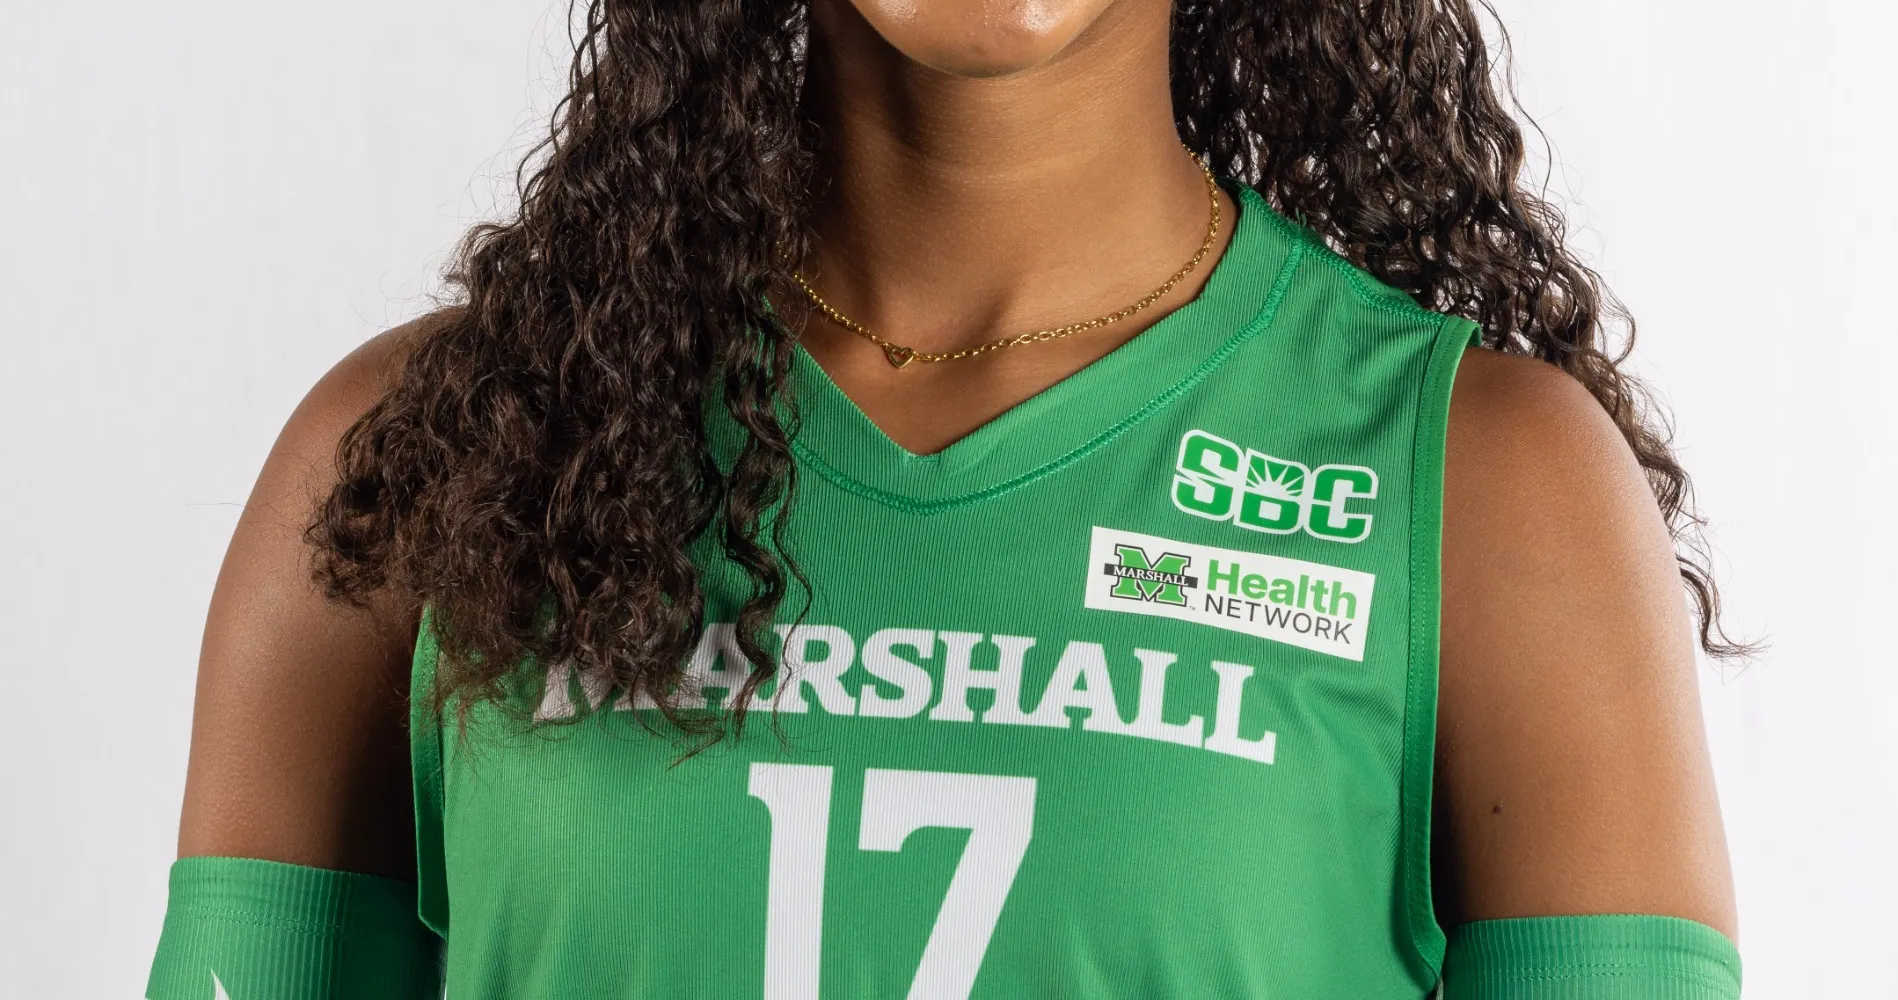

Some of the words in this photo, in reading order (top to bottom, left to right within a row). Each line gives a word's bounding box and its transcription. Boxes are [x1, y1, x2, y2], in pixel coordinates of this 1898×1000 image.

[1171, 429, 1379, 543] SBC
[1113, 565, 1189, 586] MARSHALL
[1206, 558, 1357, 620] Health
[1205, 593, 1353, 645] NETWORK
[748, 762, 1037, 1000] 17
